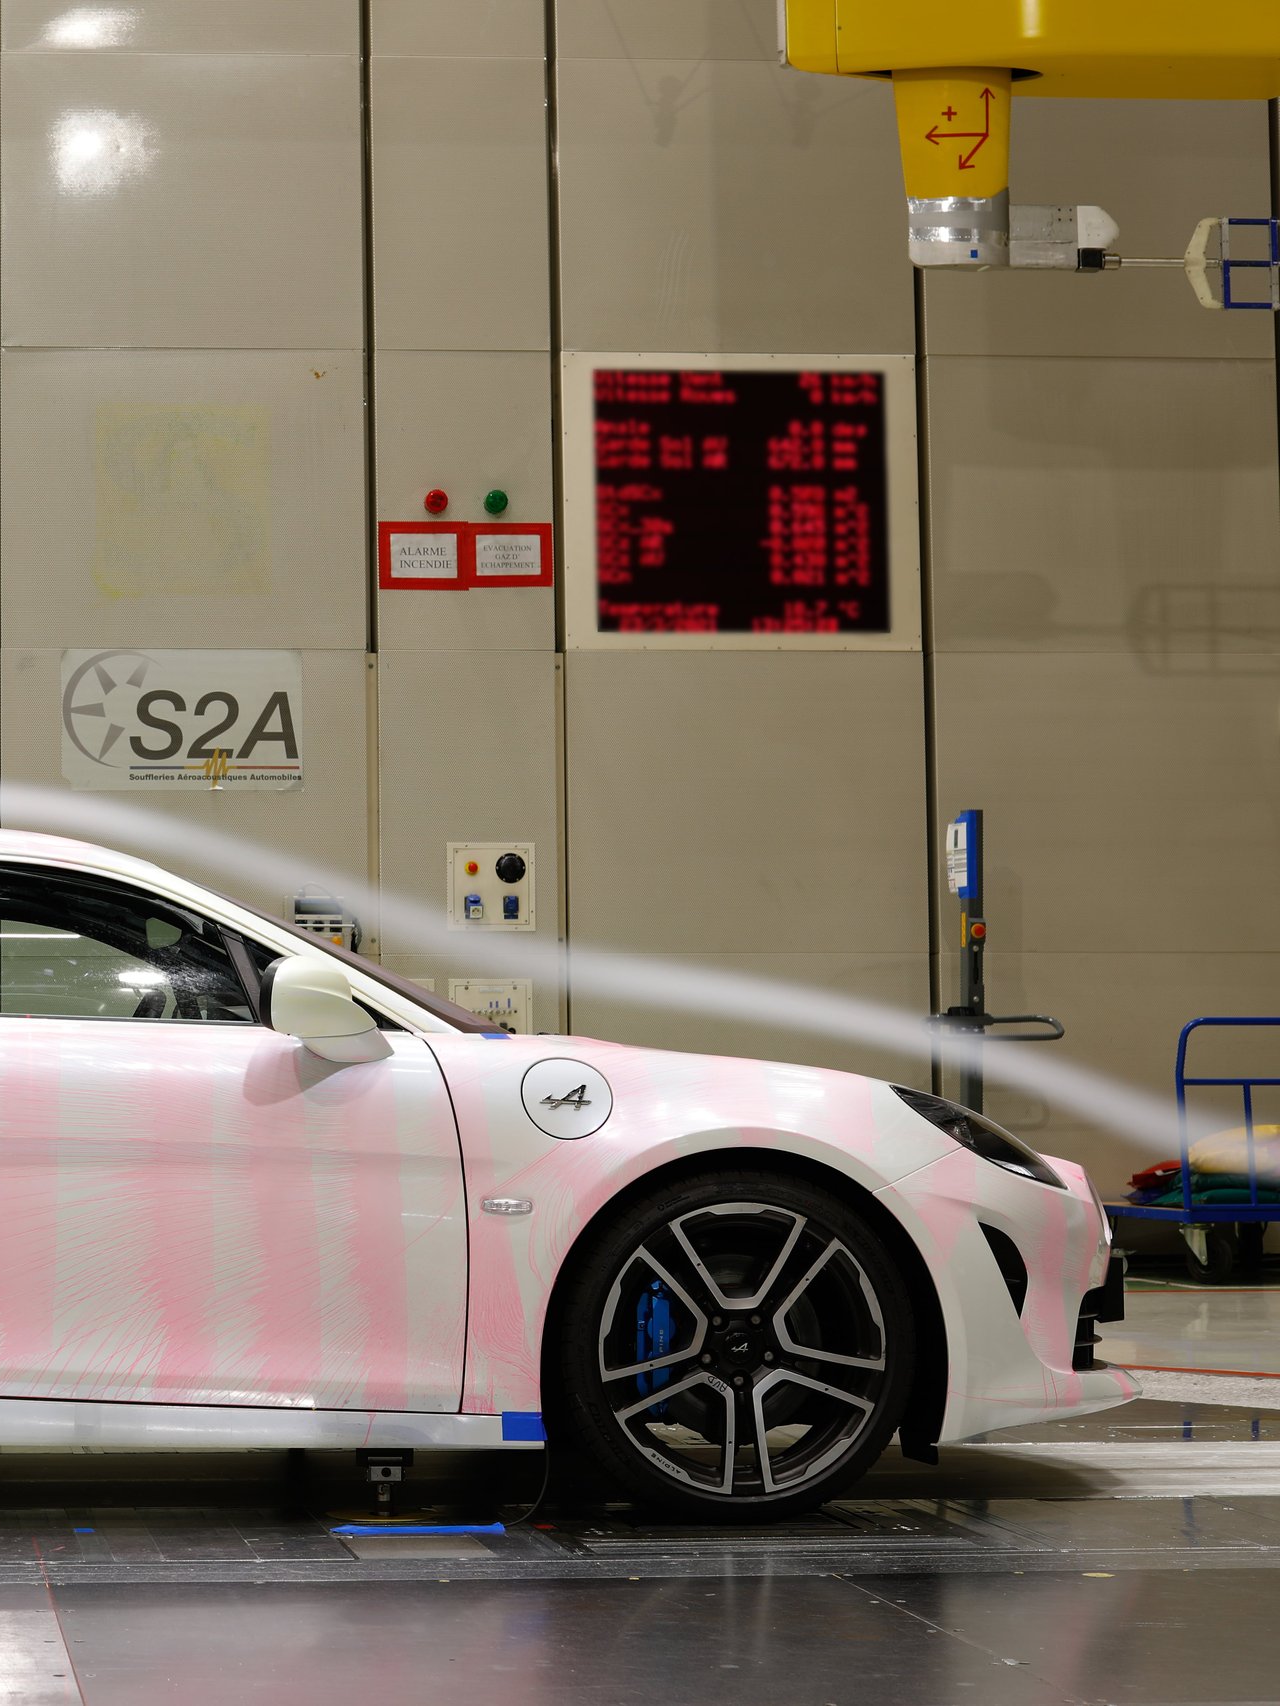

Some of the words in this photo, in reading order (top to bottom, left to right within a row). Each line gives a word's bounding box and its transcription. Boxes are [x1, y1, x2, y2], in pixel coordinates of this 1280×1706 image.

[400, 546, 447, 556] ALARME
[400, 559, 452, 569] INCENDIE
[481, 561, 535, 569] ECHAPPEMENT
[129, 689, 299, 760] S2A
[129, 773, 175, 781] Souffleries
[177, 773, 247, 782] Aéroacoustiques
[250, 773, 302, 781] Automobiles
[650, 1452, 682, 1475] ALPINE
